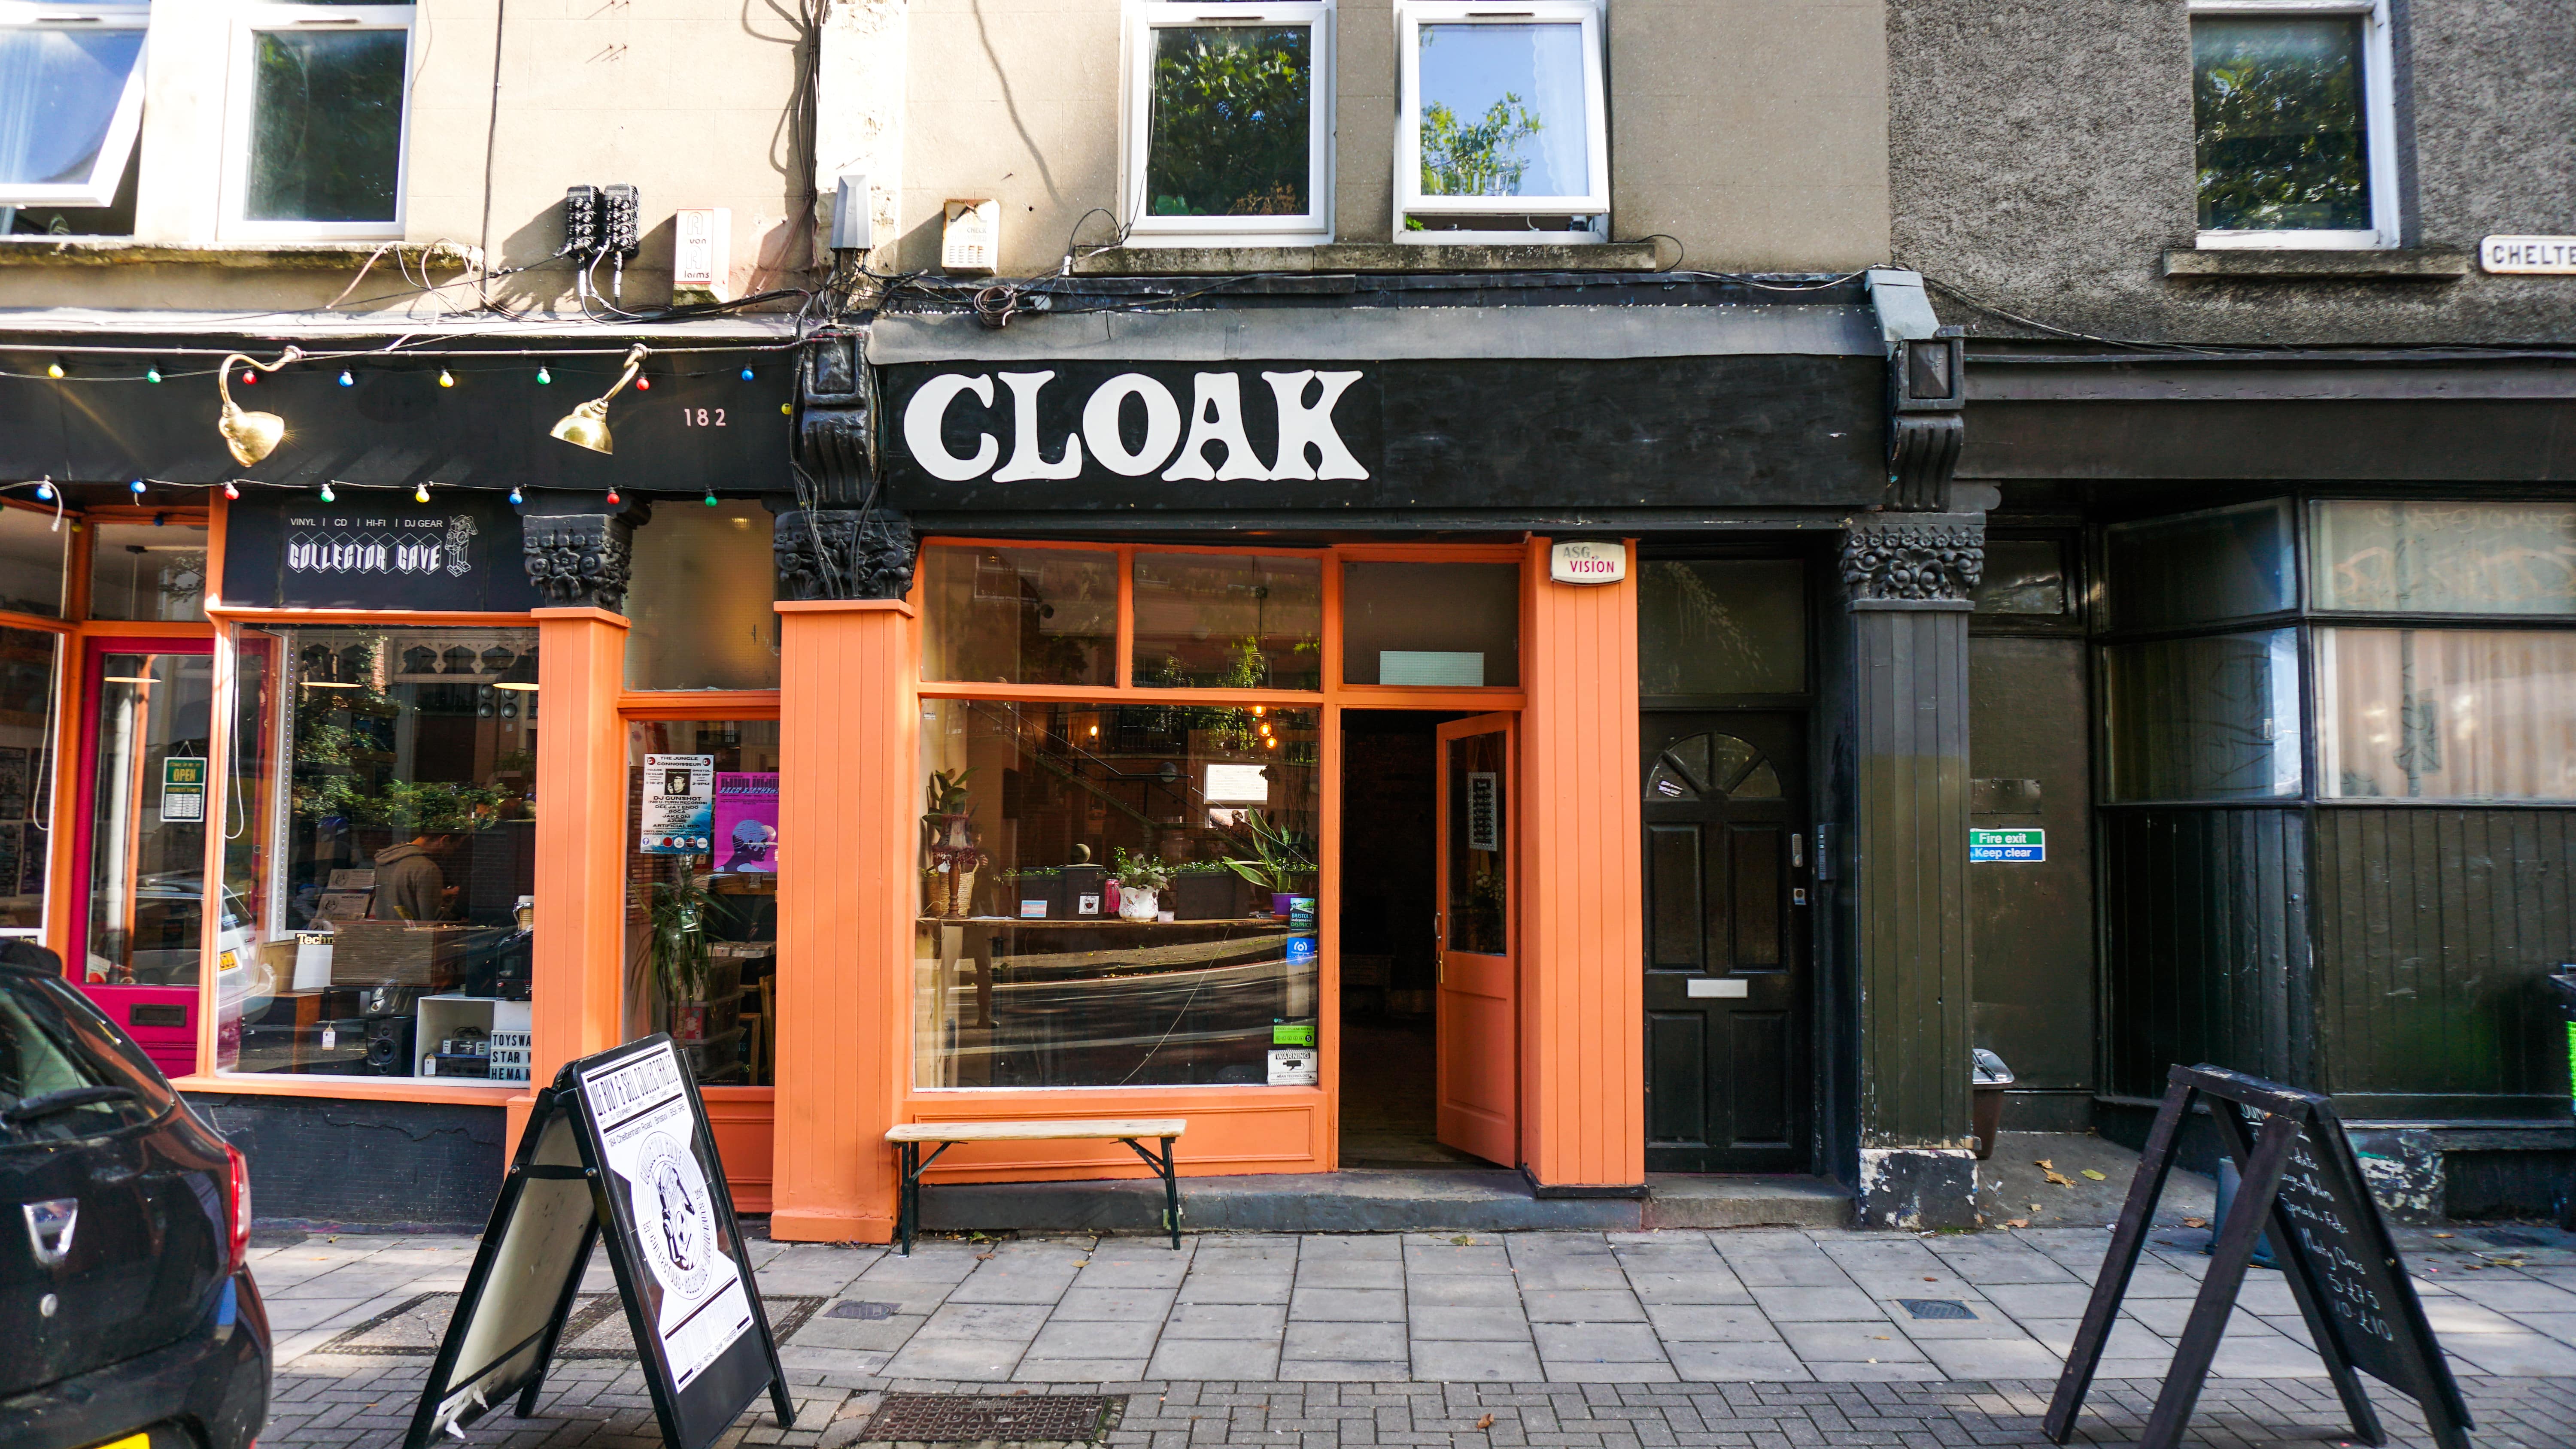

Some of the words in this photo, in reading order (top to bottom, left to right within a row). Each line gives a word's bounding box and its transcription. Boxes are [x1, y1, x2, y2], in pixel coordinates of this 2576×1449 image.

[2493, 245, 2576, 265] CHELTE
[684, 408, 726, 426] 182
[904, 369, 1370, 483] CLOAK
[290, 518, 316, 526] VINYL
[290, 543, 386, 570] COLLECTOR
[398, 544, 440, 571] CAVE
[1564, 546, 1591, 558] ASG
[1570, 558, 1614, 573] VISION
[173, 768, 196, 781] OPEN
[1979, 833, 2003, 844] Fire
[2005, 833, 2027, 844] exit
[1975, 848, 2003, 860] Keep
[2005, 848, 2032, 858] clear
[297, 934, 334, 944] Techn
[492, 1051, 520, 1063] STAR
[589, 1083, 607, 1116] WE
[601, 1078, 619, 1112] BUY
[621, 1070, 640, 1103] SELL
[634, 1054, 678, 1097] COLLECTABLES
[616, 1124, 642, 1144] Cheltenham
[641, 1119, 653, 1131] Road
[654, 1113, 668, 1125] Bristol
